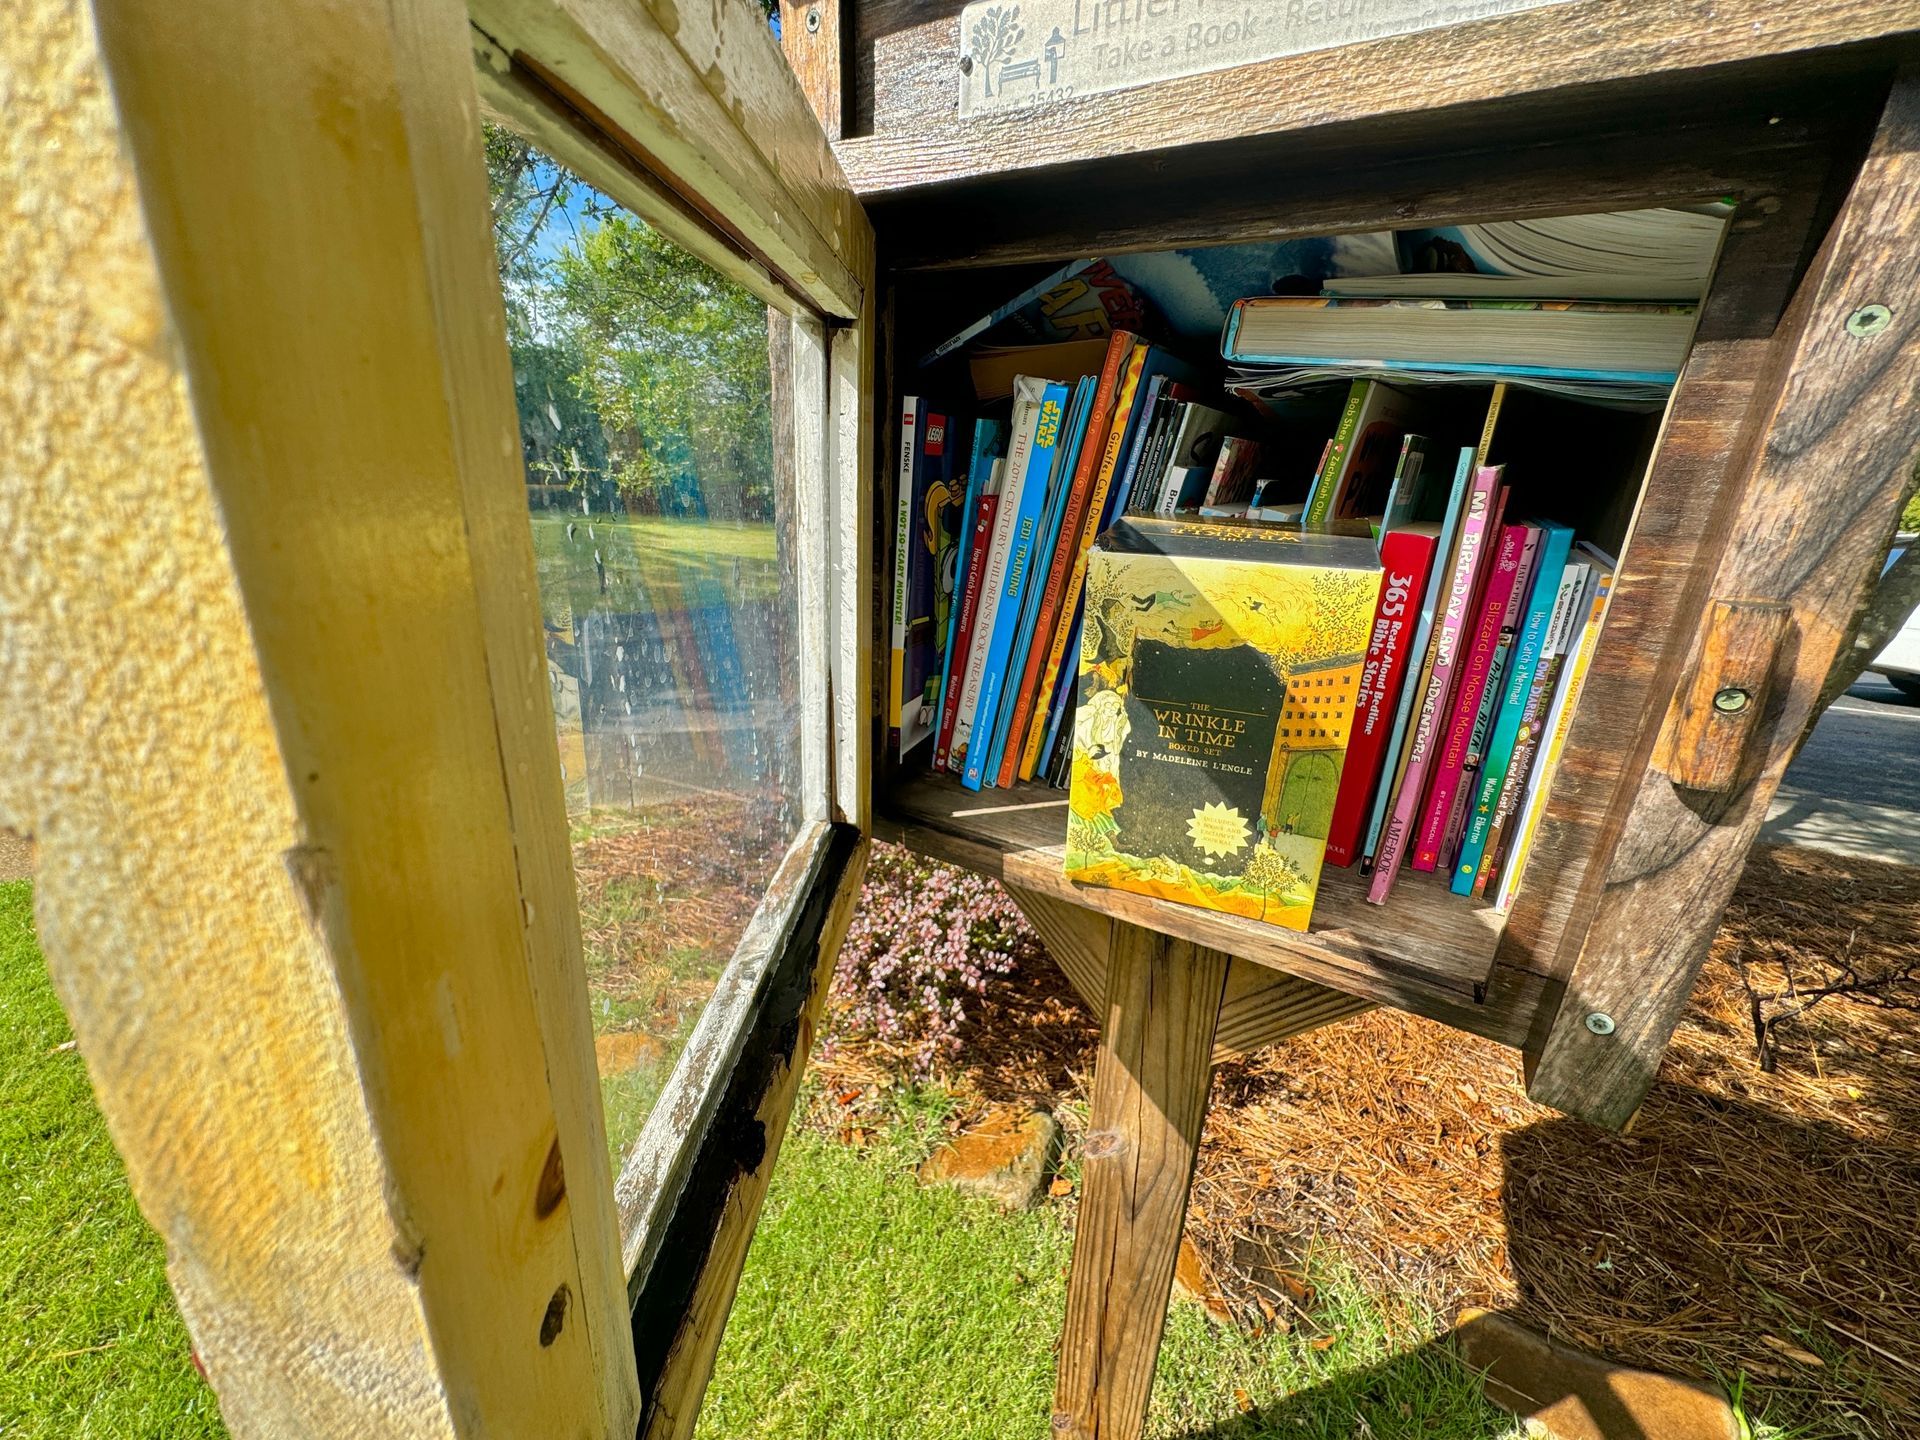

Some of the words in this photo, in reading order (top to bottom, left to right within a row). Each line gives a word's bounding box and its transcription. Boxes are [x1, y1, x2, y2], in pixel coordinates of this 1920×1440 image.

[1092, 37, 1154, 71] Take
[1159, 35, 1176, 57] a
[1185, 9, 1260, 53] Book
[1029, 85, 1074, 106] 35432
[1346, 396, 1359, 416] Bob
[928, 425, 945, 445] LEGO
[1036, 401, 1053, 448] WARS
[1046, 400, 1061, 447] STAR
[1338, 416, 1352, 441] Shea
[1014, 433, 1027, 456] THE
[1101, 432, 1119, 474] Giraffes
[1131, 425, 1146, 462] Imagination
[1143, 436, 1152, 451] GREAT
[1155, 434, 1164, 450] GREAT
[1139, 452, 1147, 464] DAYS
[1151, 451, 1159, 463] DAYS
[1131, 464, 1144, 491] OUTDOORS
[1142, 463, 1156, 490] OUTDOORS
[1318, 454, 1339, 499] Zachariah
[1092, 478, 1107, 503] Can't
[1059, 493, 1081, 544] PANCAKES
[1469, 491, 1487, 521] MY
[1021, 515, 1034, 541] JEDI
[1085, 508, 1100, 537] Dance
[896, 510, 907, 577] NOT-SO-SCARY
[971, 547, 982, 562] How
[1056, 547, 1066, 565] FOR
[966, 571, 978, 589] Catch
[1008, 540, 1028, 597] TRAINING
[1448, 532, 1479, 620] BIRTHDAY
[1517, 564, 1527, 585] HALE
[982, 551, 1003, 620] CHILDREN'S
[1045, 569, 1062, 608] SUPPER!
[1382, 571, 1413, 616] 365
[894, 580, 903, 624] MONSTER!
[957, 594, 974, 632] Loveosaurus
[1507, 592, 1520, 615] PHAM
[1053, 612, 1070, 652] Parker-Rees
[1435, 612, 1444, 625] THE
[1477, 601, 1501, 653] Blizzard
[1531, 611, 1546, 630] How
[975, 621, 989, 652] BOOK
[1369, 619, 1390, 656] Bible
[1429, 628, 1440, 646] COZY
[1438, 626, 1456, 667] LAND
[1527, 631, 1537, 641] to
[1376, 620, 1403, 690] Read-Aloud
[1424, 650, 1435, 670] BOOK
[1472, 655, 1484, 670] on
[1520, 641, 1537, 663] Catch
[1533, 661, 1549, 684] OWL
[1548, 656, 1560, 676] OWL
[965, 656, 982, 710] TREASURY
[1356, 660, 1379, 708] Stories
[1461, 676, 1481, 713] Moose
[1485, 660, 1501, 704] Princess
[1509, 670, 1528, 706] Mermaid
[1567, 676, 1580, 702] TOOTH
[1190, 702, 1211, 712] THE
[1522, 685, 1542, 723] DIARIES
[1537, 681, 1553, 717] DIARIES
[1153, 709, 1247, 734] WRINKLE
[1364, 691, 1384, 735] Bedtime
[1411, 676, 1443, 763] ADVENTURE
[1555, 705, 1571, 740] TROUBLE
[1157, 724, 1179, 740] IN
[1185, 729, 1237, 748] TIME
[1445, 715, 1469, 770] Mountain
[1470, 712, 1487, 749] BLACK
[1136, 749, 1149, 759] BY
[1152, 752, 1209, 768] MADELEINE
[1213, 762, 1253, 776] L'ENGLE
[1168, 741, 1200, 754] BOXED
[1203, 747, 1223, 757] SET
[1513, 744, 1524, 759] Eva
[1508, 761, 1519, 776] and
[1517, 747, 1532, 783] Woodland
[1439, 790, 1446, 798] BY
[1481, 777, 1497, 803] Wallace
[1503, 776, 1515, 791] the
[1433, 799, 1444, 815] JULIE
[1498, 791, 1510, 809] Lost
[1507, 783, 1521, 815] Wedding
[1391, 816, 1403, 826] A
[1427, 817, 1440, 844] DRISCOLL
[1471, 816, 1486, 844] Elkerton
[1491, 809, 1505, 829] Pony
[1422, 853, 1429, 861] 2
